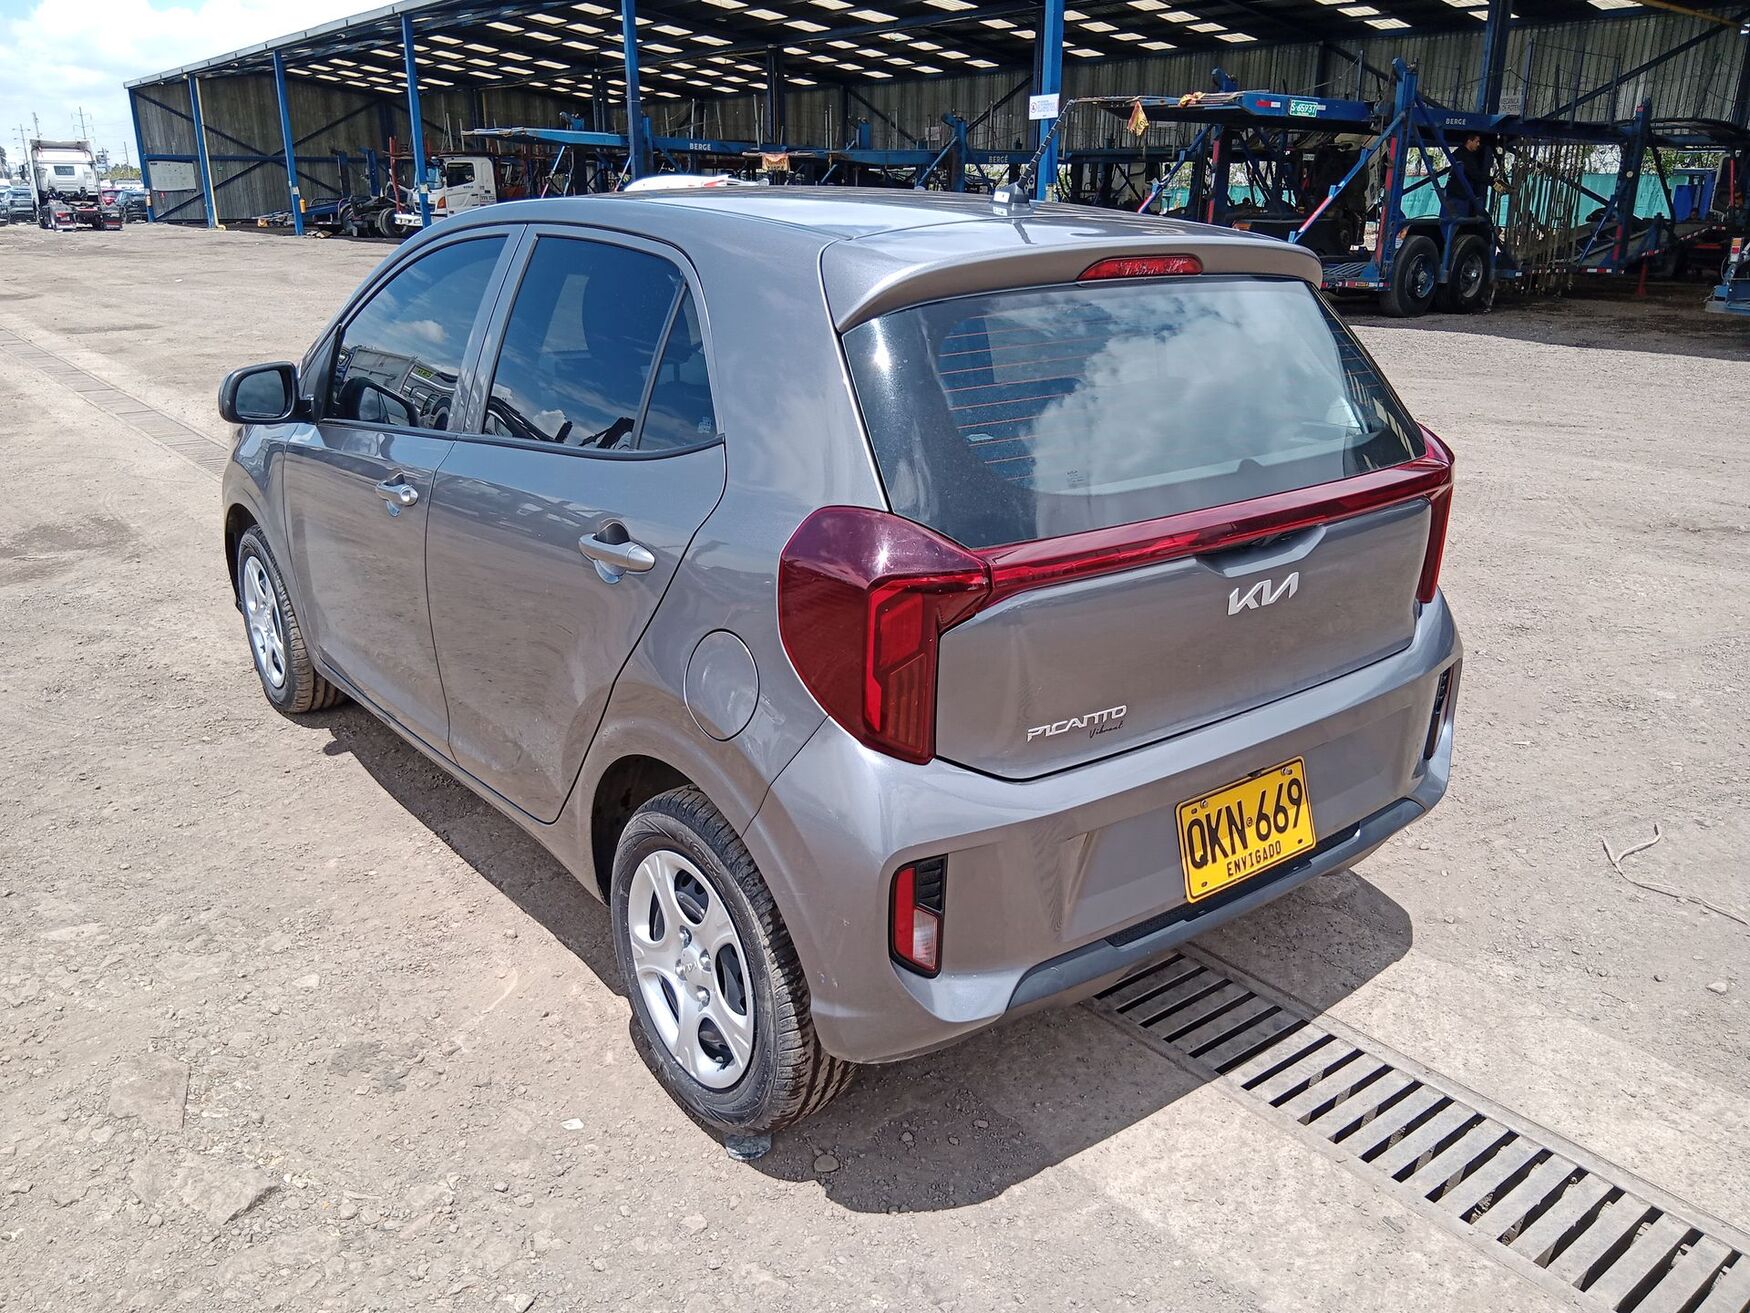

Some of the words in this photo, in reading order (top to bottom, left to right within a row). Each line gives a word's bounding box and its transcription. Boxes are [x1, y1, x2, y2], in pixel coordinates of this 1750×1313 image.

[1227, 571, 1300, 616] KIA
[1026, 704, 1127, 742] PICANTO
[1186, 800, 1249, 870] QKN
[1255, 777, 1303, 842] 669
[1226, 840, 1282, 877] ENVIGADO
